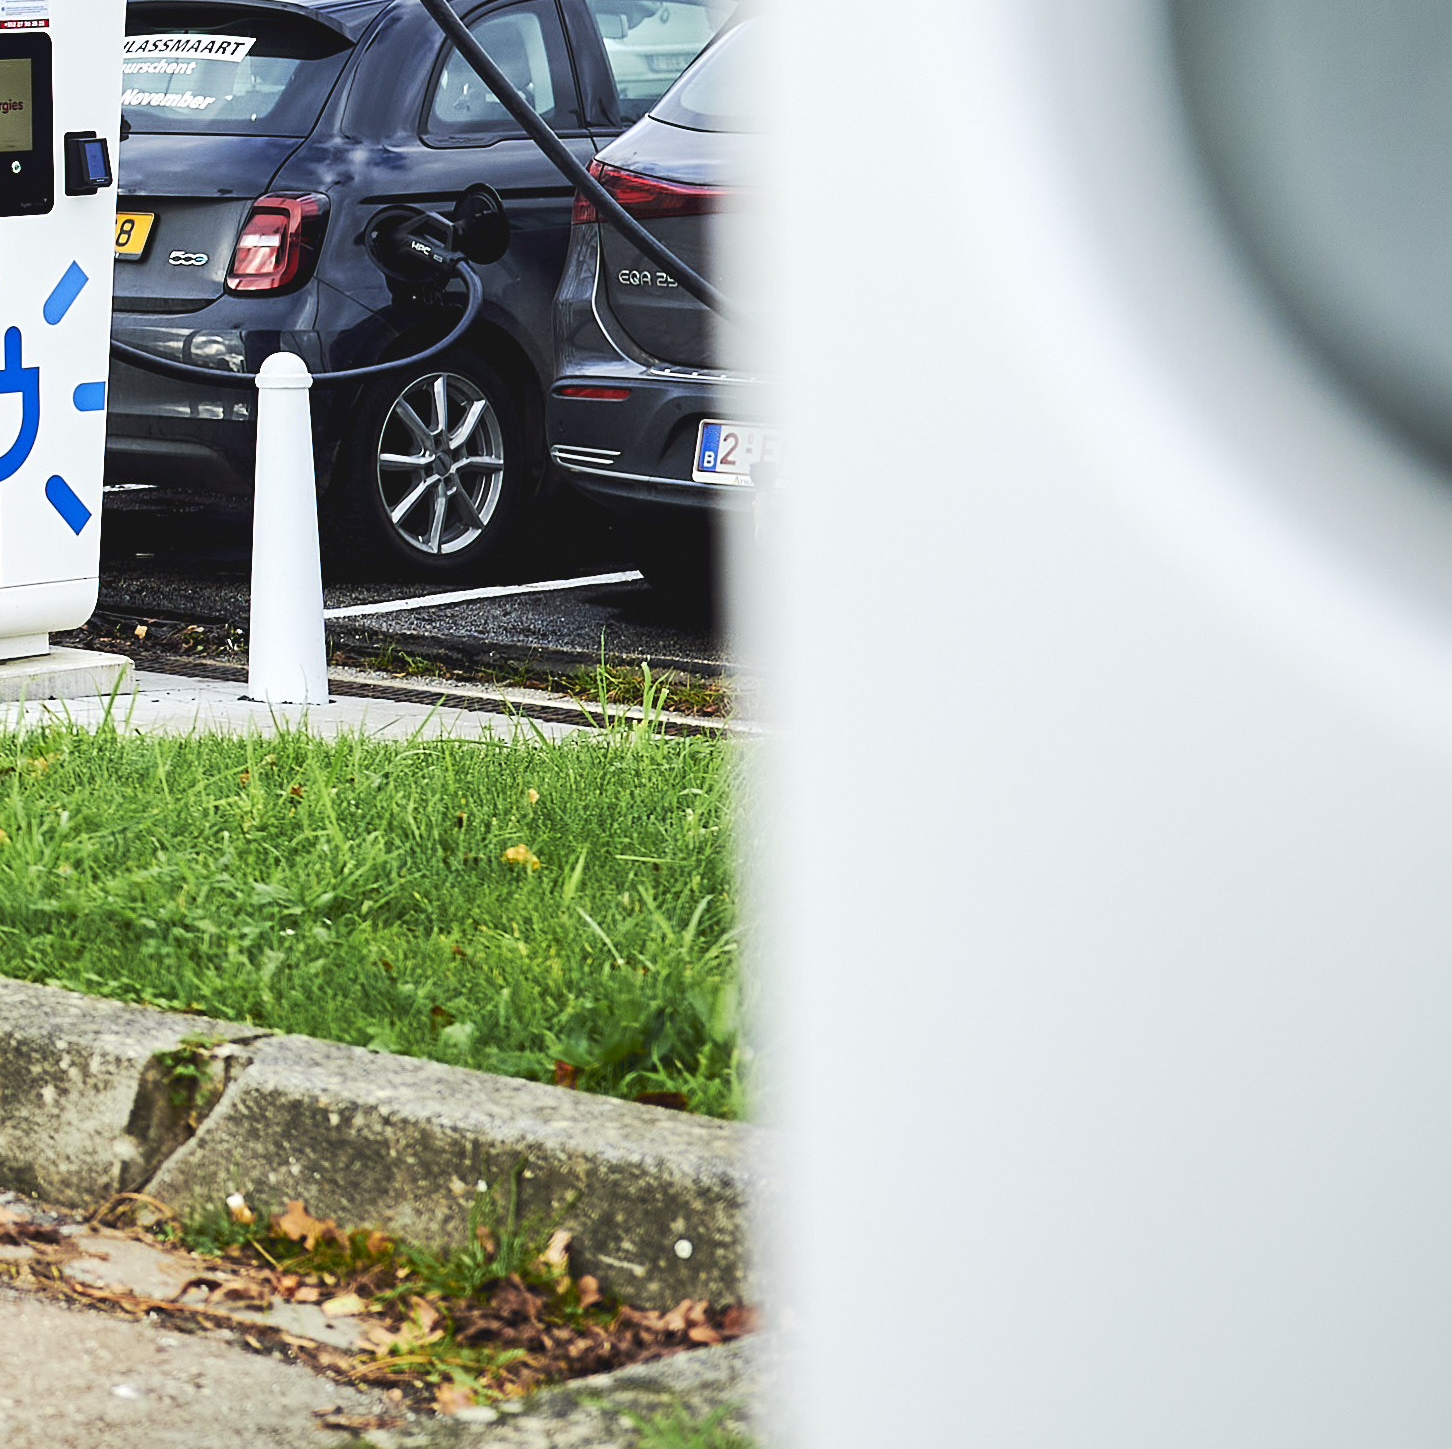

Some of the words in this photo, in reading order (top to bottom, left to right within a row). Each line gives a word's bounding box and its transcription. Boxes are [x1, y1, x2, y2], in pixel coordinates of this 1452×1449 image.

[121, 88, 216, 110] November
[115, 218, 136, 248] 8
[411, 240, 432, 256] HPC
[168, 250, 208, 266] 500
[618, 269, 652, 286] EQA
[703, 450, 715, 467] B
